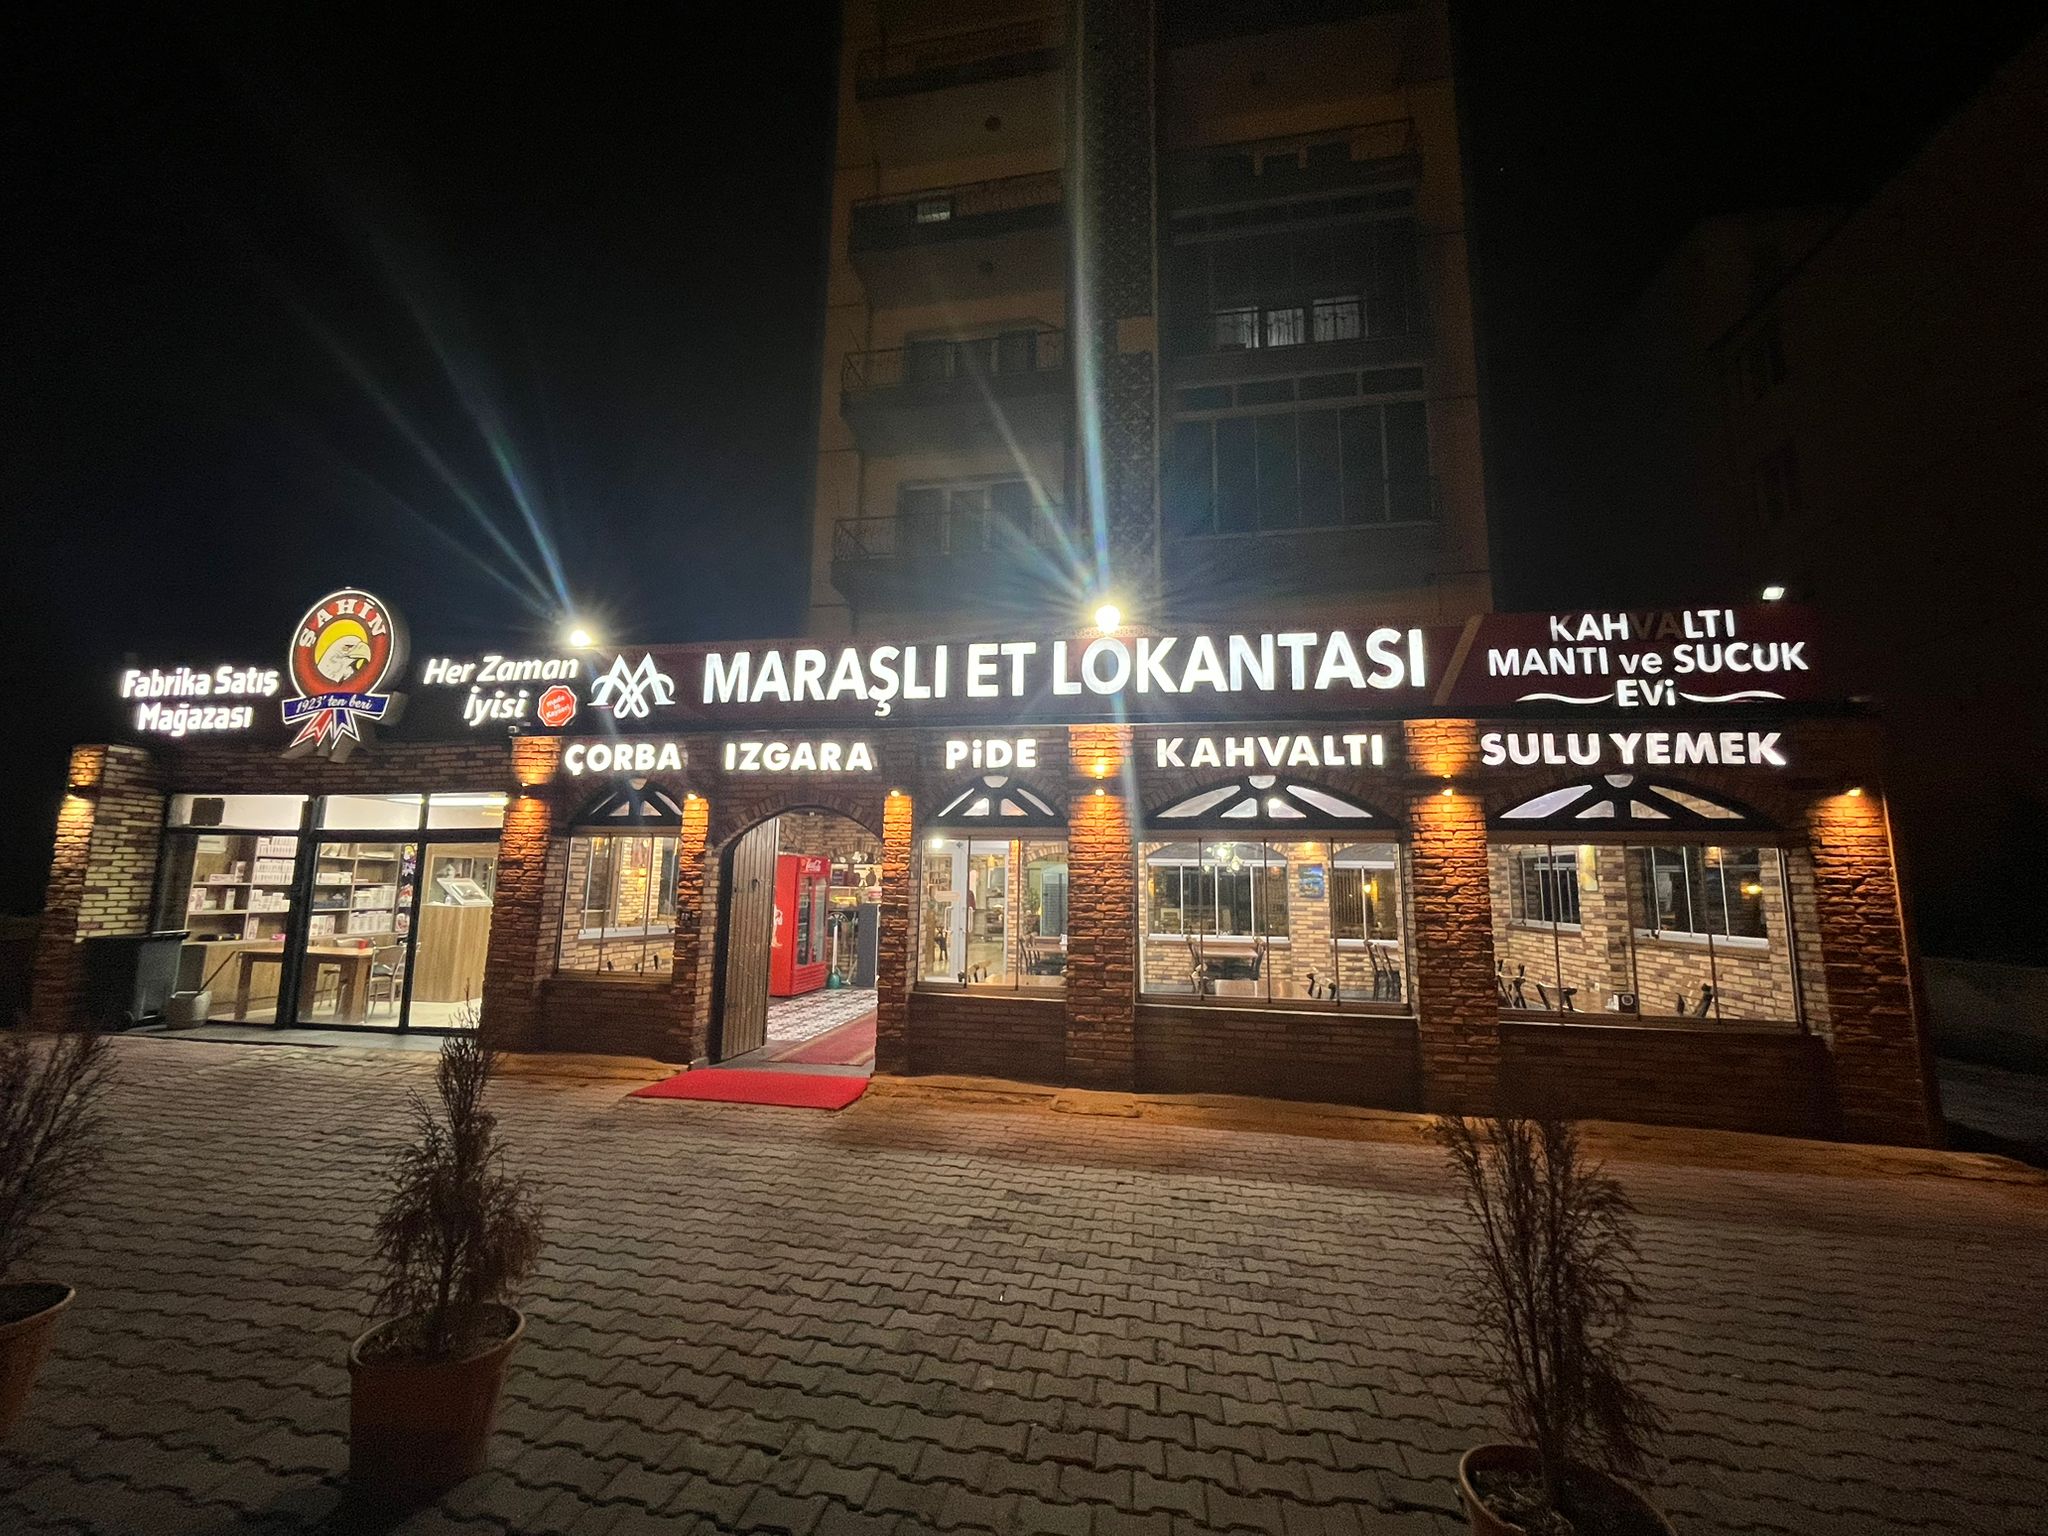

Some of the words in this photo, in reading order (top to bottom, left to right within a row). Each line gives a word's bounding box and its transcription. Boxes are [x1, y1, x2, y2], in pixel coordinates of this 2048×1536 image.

[1550, 609, 1736, 642] KAHVALTI
[422, 658, 476, 685] Her
[476, 655, 580, 682] Zaman
[702, 644, 948, 716] MARAŞLI
[966, 641, 1037, 697] ET
[1052, 628, 1426, 696] LOKANTASI
[1488, 647, 1609, 676] MANTI
[1618, 652, 1663, 674] ve
[1673, 641, 1809, 673] SUCUK
[121, 667, 210, 698] Fabrika
[213, 665, 281, 697] Satış
[136, 701, 254, 737] Mağazası
[348, 694, 372, 710] beri
[463, 685, 530, 727] İyisi
[563, 742, 683, 776] ÇORBA
[724, 742, 874, 772] IZGARA
[1155, 733, 1385, 768] KAHVALTI
[1480, 732, 1600, 766] SULU
[1607, 732, 1787, 766] YEMEK
